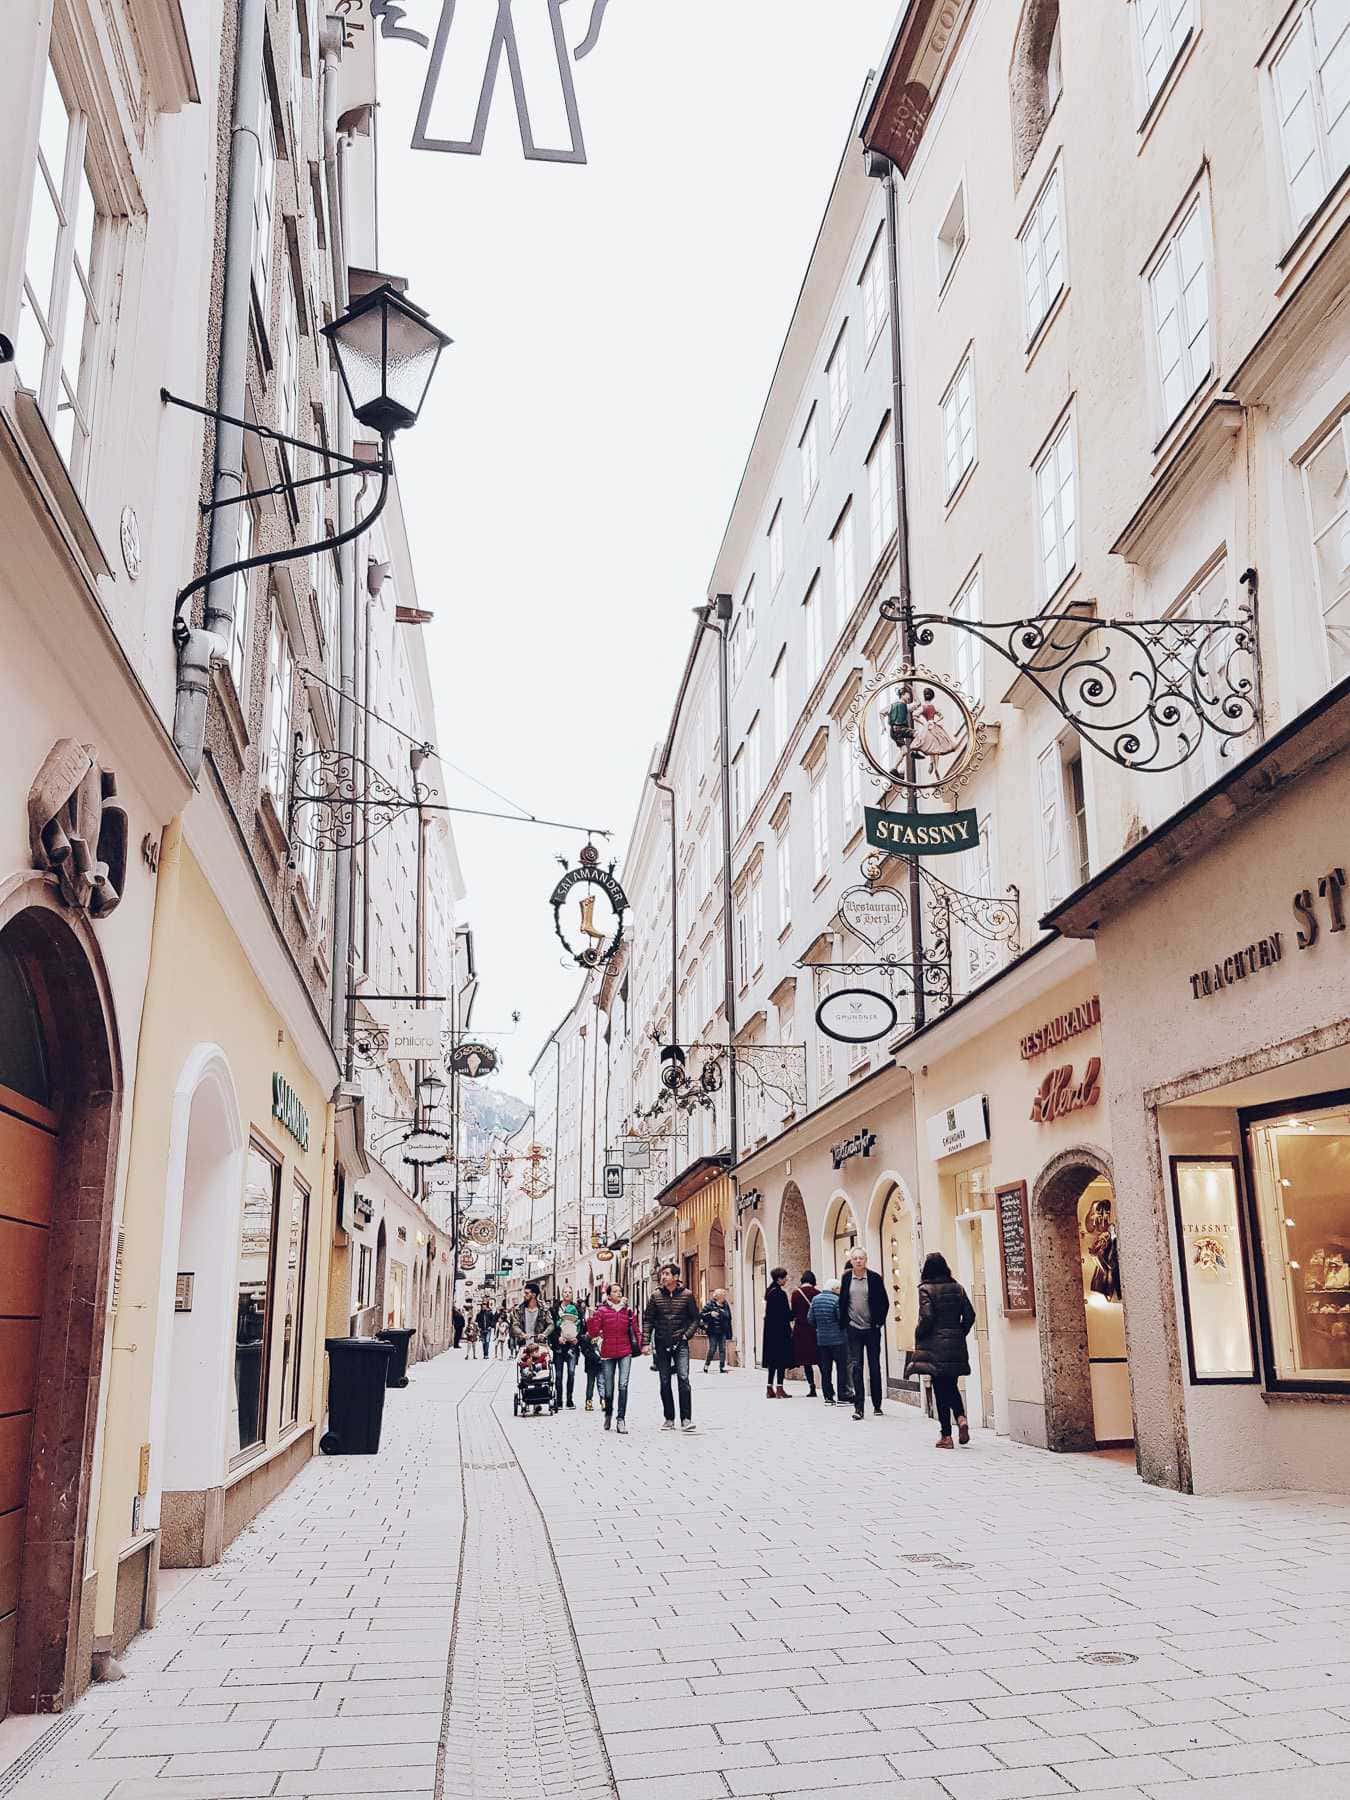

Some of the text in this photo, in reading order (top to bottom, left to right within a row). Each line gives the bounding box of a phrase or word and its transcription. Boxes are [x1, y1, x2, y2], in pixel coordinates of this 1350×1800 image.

[876, 820, 969, 845] STASSNY
[557, 868, 623, 900] SALAMANDER
[845, 901, 901, 913] Restaurant
[1190, 932, 1282, 1000] TRACHTEN
[1020, 995, 1100, 1060] RESTAURANT
